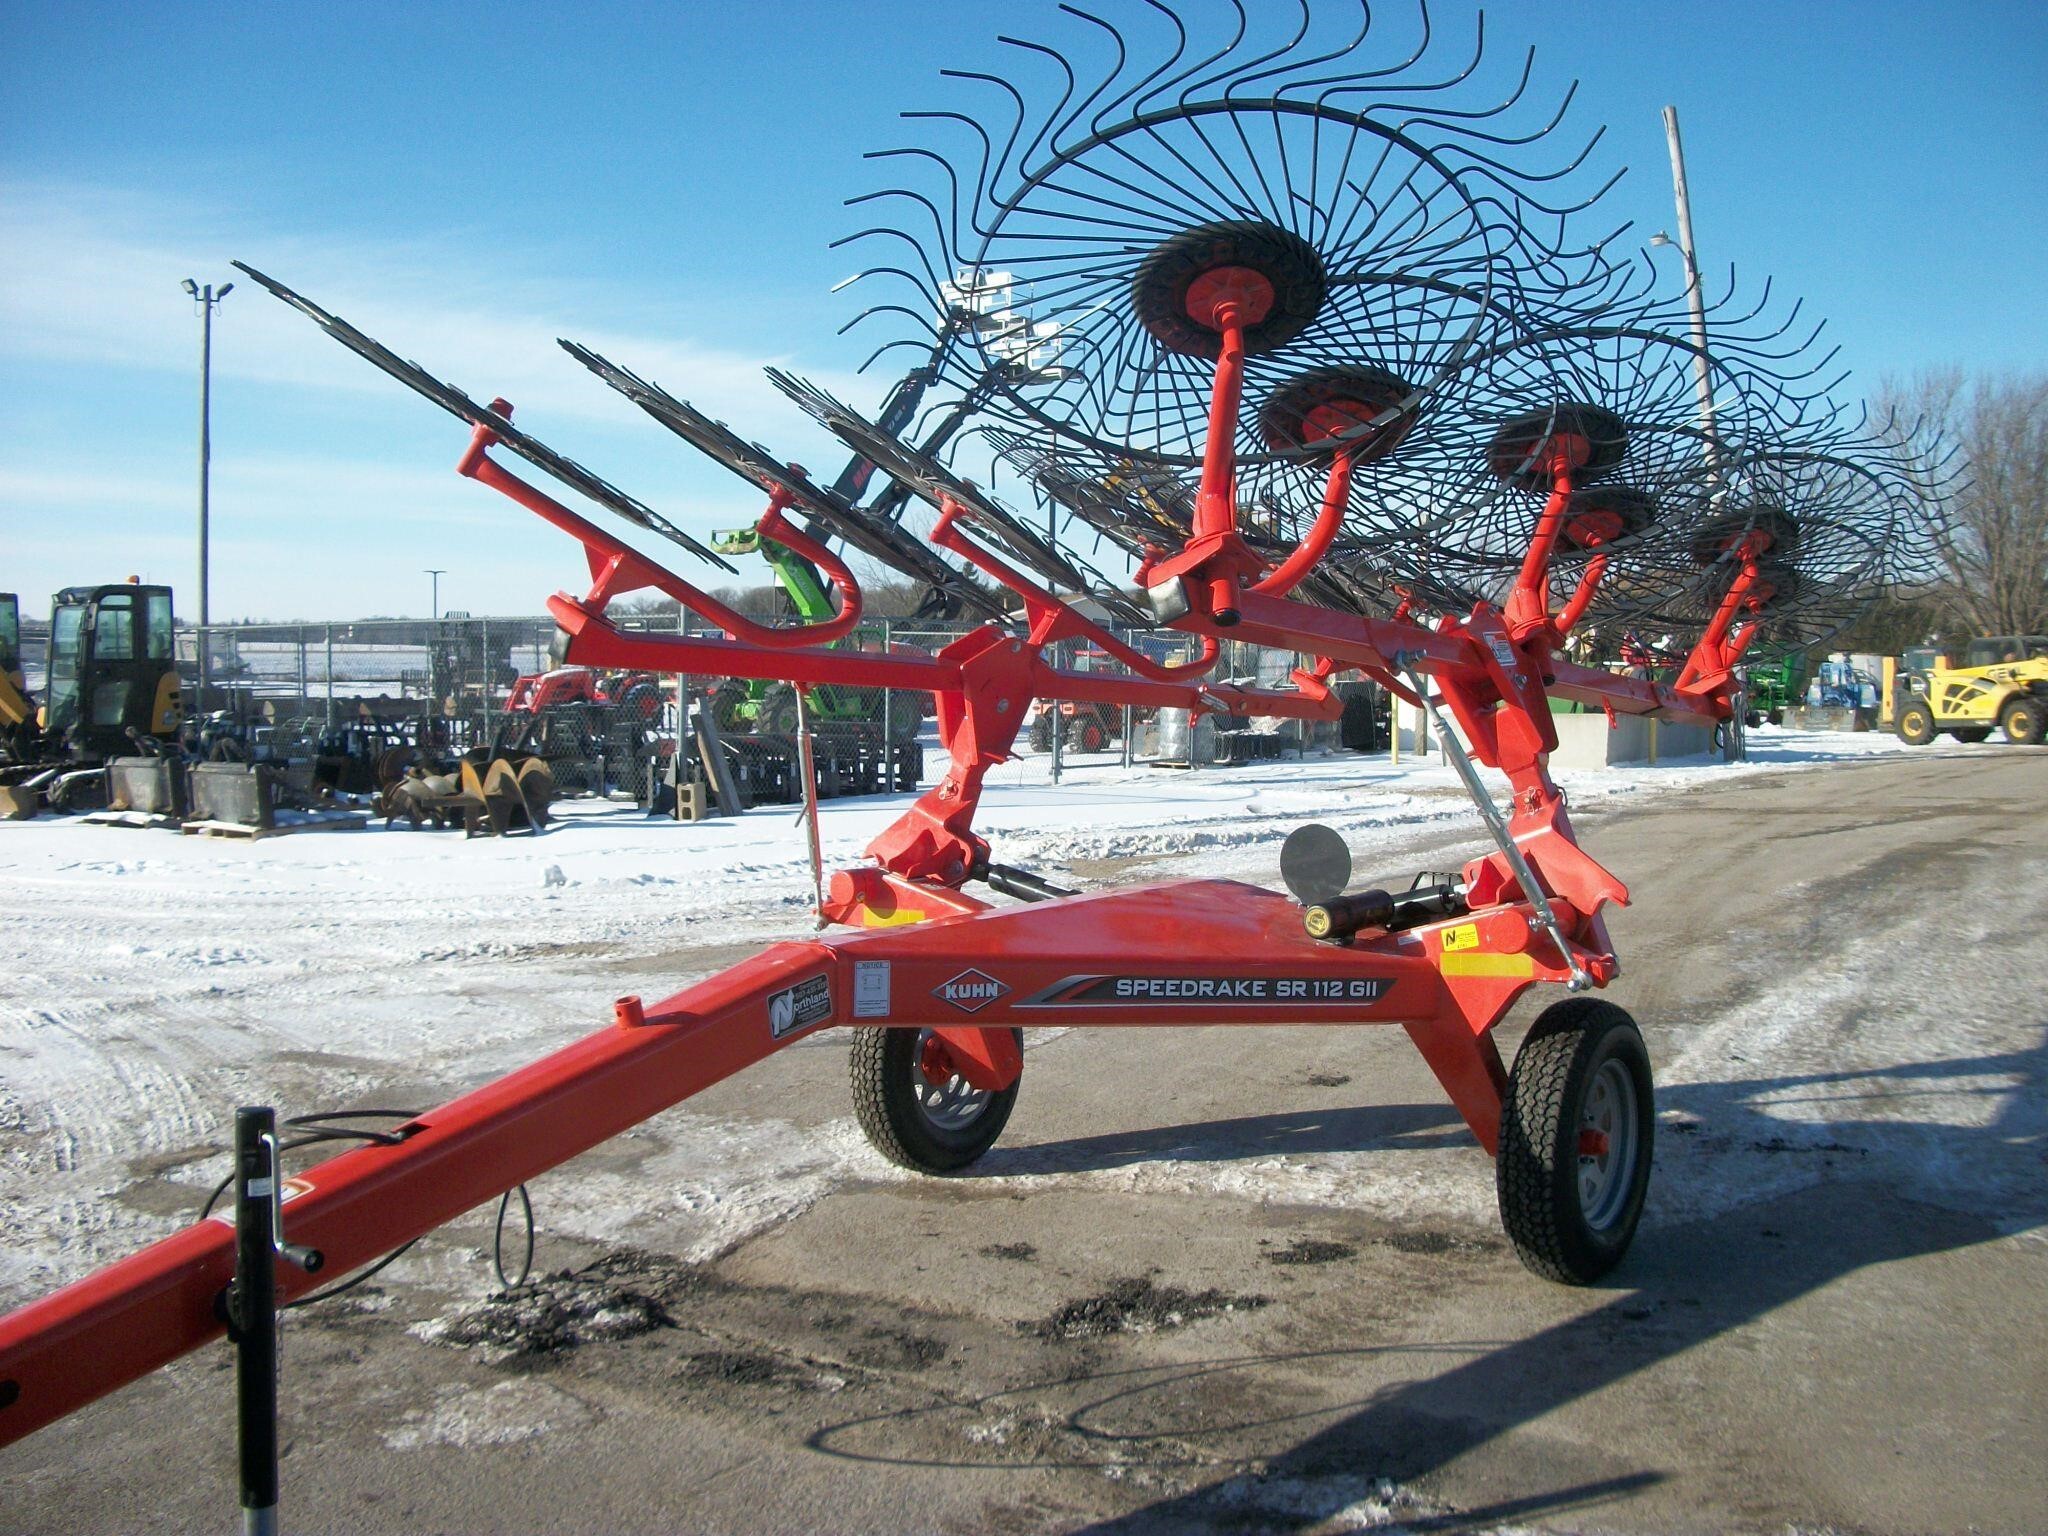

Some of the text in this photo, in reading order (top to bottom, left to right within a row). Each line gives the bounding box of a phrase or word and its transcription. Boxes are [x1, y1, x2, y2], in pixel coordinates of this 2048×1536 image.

[945, 983, 998, 999] KUHN
[1115, 979, 1377, 997] SPEEDRAKE SR 112 GII
